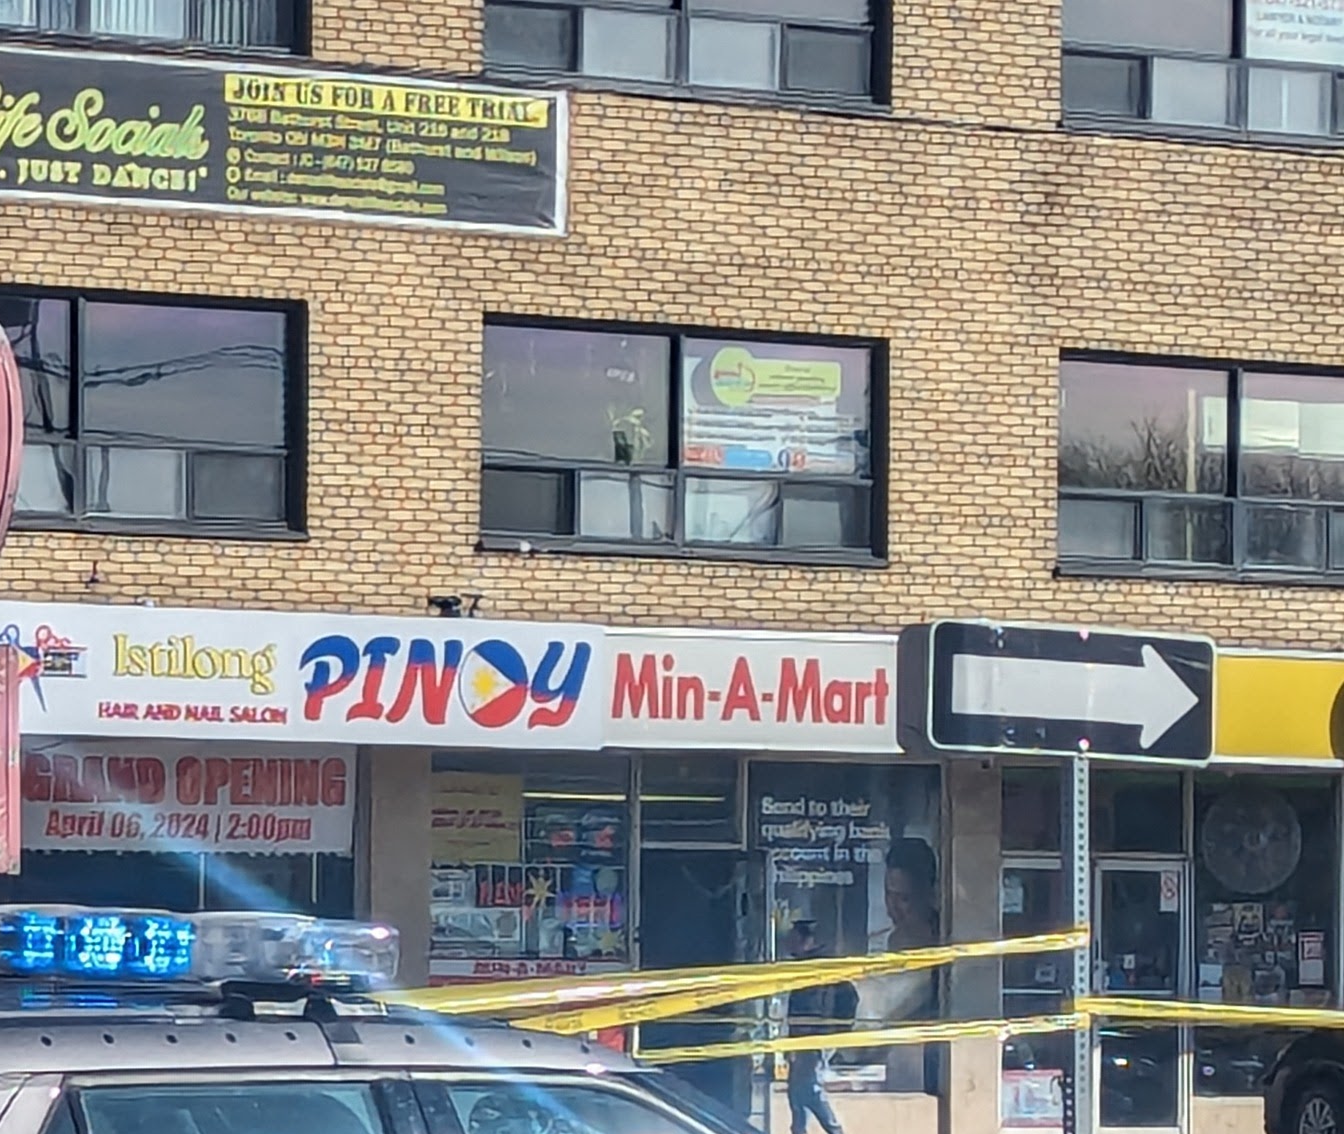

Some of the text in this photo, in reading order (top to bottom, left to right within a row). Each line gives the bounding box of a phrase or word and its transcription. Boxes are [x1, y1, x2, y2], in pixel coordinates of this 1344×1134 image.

[46, 88, 210, 161] Socials
[232, 79, 286, 102] JOIN
[296, 83, 323, 105] US
[331, 87, 374, 110] FOR
[382, 90, 396, 111] A
[404, 93, 460, 116] FREE
[17, 158, 83, 186] JUST
[113, 633, 278, 696] Istilong
[297, 634, 592, 731] PINOY
[611, 652, 891, 727] Min-A-Mart
[98, 701, 289, 725] HAIR AND NAIL SALON
[23, 753, 348, 808] GRAND OPENING
[45, 808, 105, 840] April
[149, 811, 209, 841] 2024
